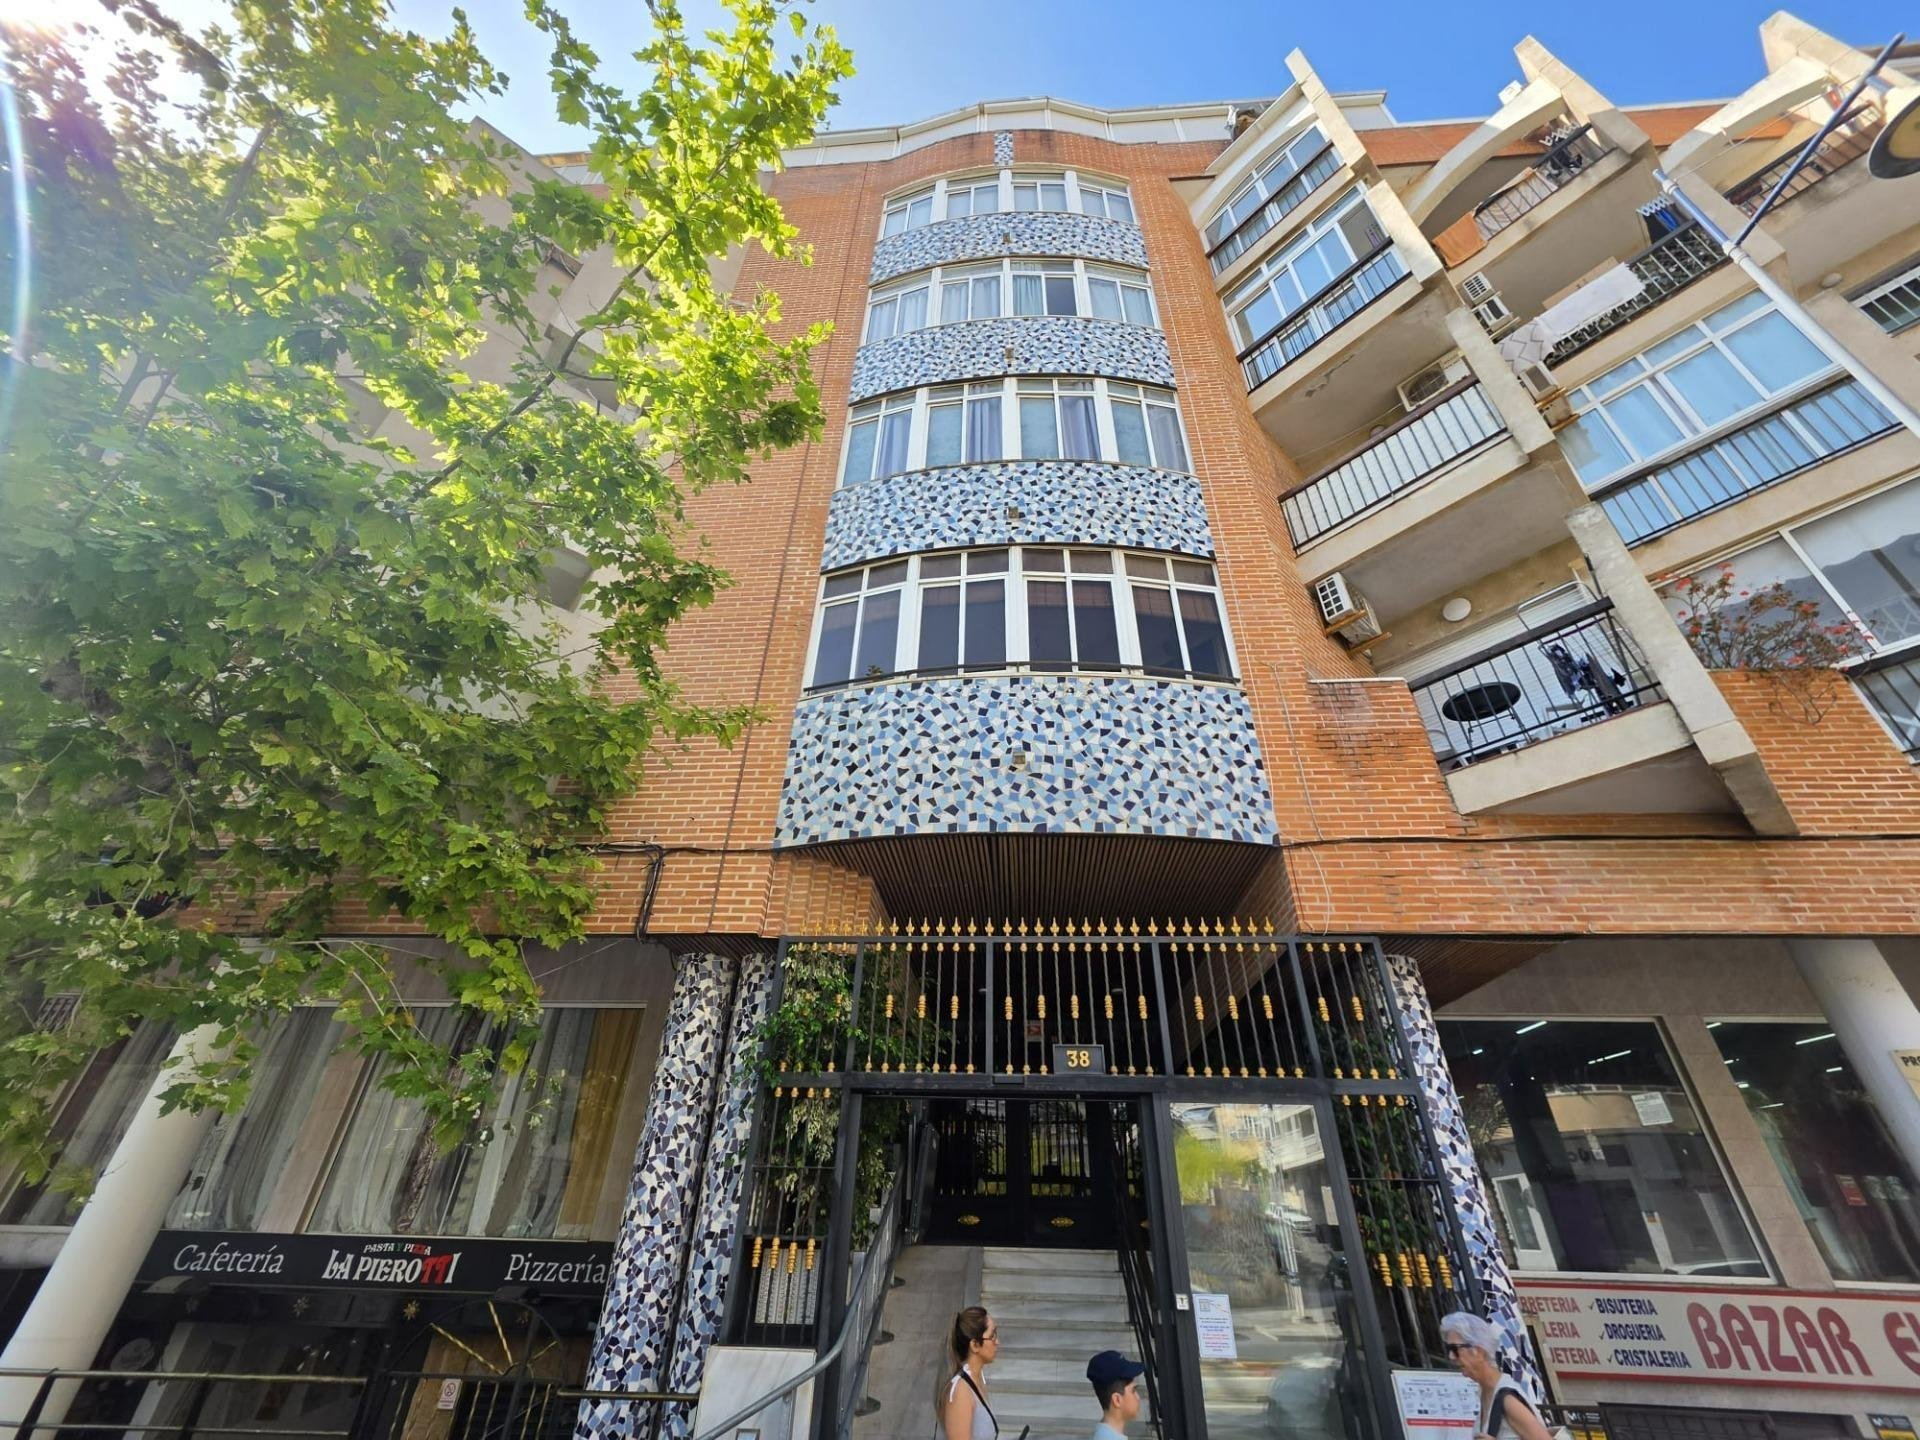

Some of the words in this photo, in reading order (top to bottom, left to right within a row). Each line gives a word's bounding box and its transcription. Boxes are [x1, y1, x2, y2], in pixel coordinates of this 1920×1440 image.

[1066, 1049, 1090, 1068] 38
[173, 1241, 285, 1274] Cafetería
[363, 1242, 395, 1254] PASTA
[402, 1243, 432, 1256] PIZZA
[321, 1249, 355, 1280] LA
[352, 1252, 462, 1285] PIEROTTI
[504, 1252, 606, 1284] Pizzería
[1595, 1298, 1658, 1315] BISUTERIA
[1604, 1323, 1666, 1341] DROGUERIA
[1686, 1302, 1873, 1377] BAZAR
[1613, 1348, 1692, 1368] CRISTALERIA
